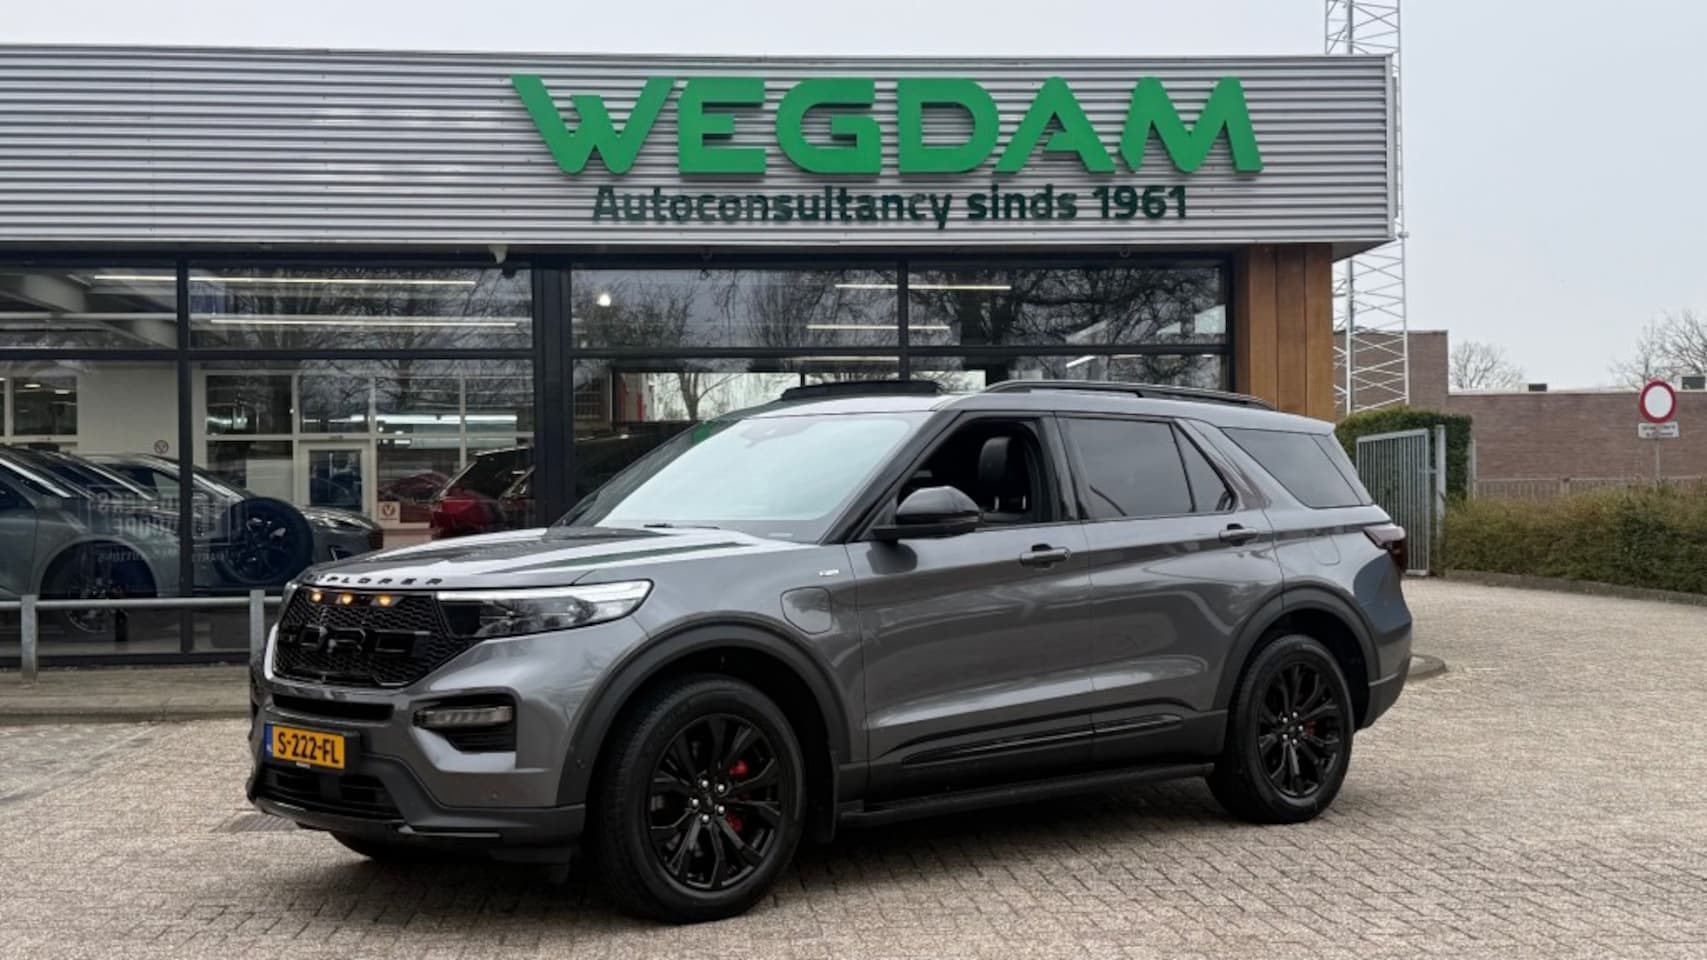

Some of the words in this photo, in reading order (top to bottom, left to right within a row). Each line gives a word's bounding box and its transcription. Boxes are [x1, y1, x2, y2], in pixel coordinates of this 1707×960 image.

[511, 74, 1264, 175] WEGDAM
[592, 185, 952, 230] Autoconsultancy
[966, 183, 1078, 219] sinds
[1091, 185, 1187, 219] 1961
[278, 731, 340, 764] S-222-FL
